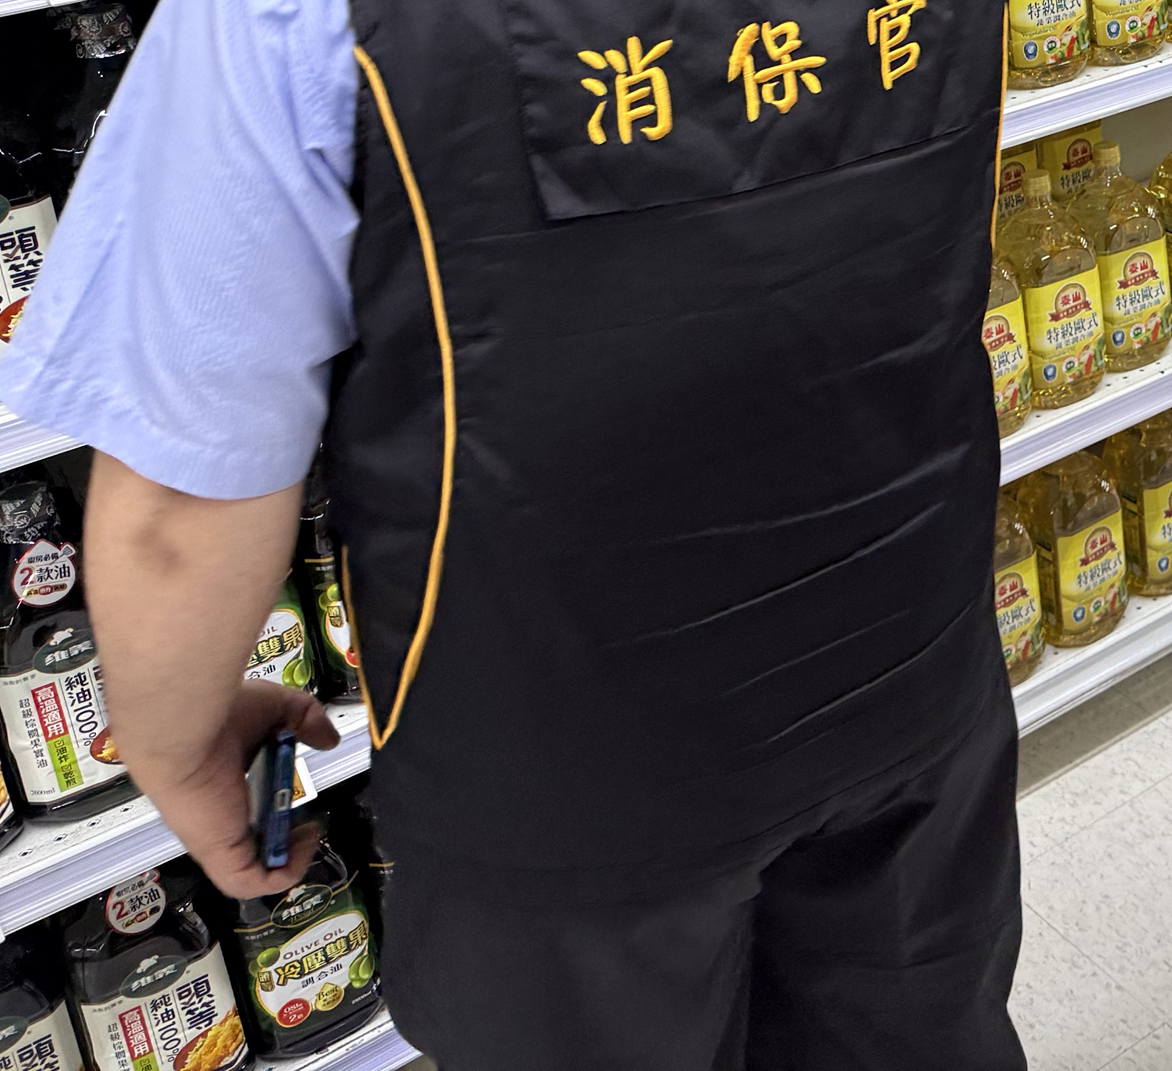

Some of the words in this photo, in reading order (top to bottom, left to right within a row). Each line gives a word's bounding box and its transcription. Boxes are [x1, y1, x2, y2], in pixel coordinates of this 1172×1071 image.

[1115, 281, 1166, 310] 特級歐式
[1047, 312, 1099, 343] 特級歐式
[35, 687, 65, 737] 高溫適用
[275, 920, 368, 986] 冷壓雙果
[283, 939, 320, 960] OLIVE
[324, 928, 345, 942] OIL
[176, 974, 218, 1030] 頭等
[123, 1010, 149, 1058] 高溫適用
